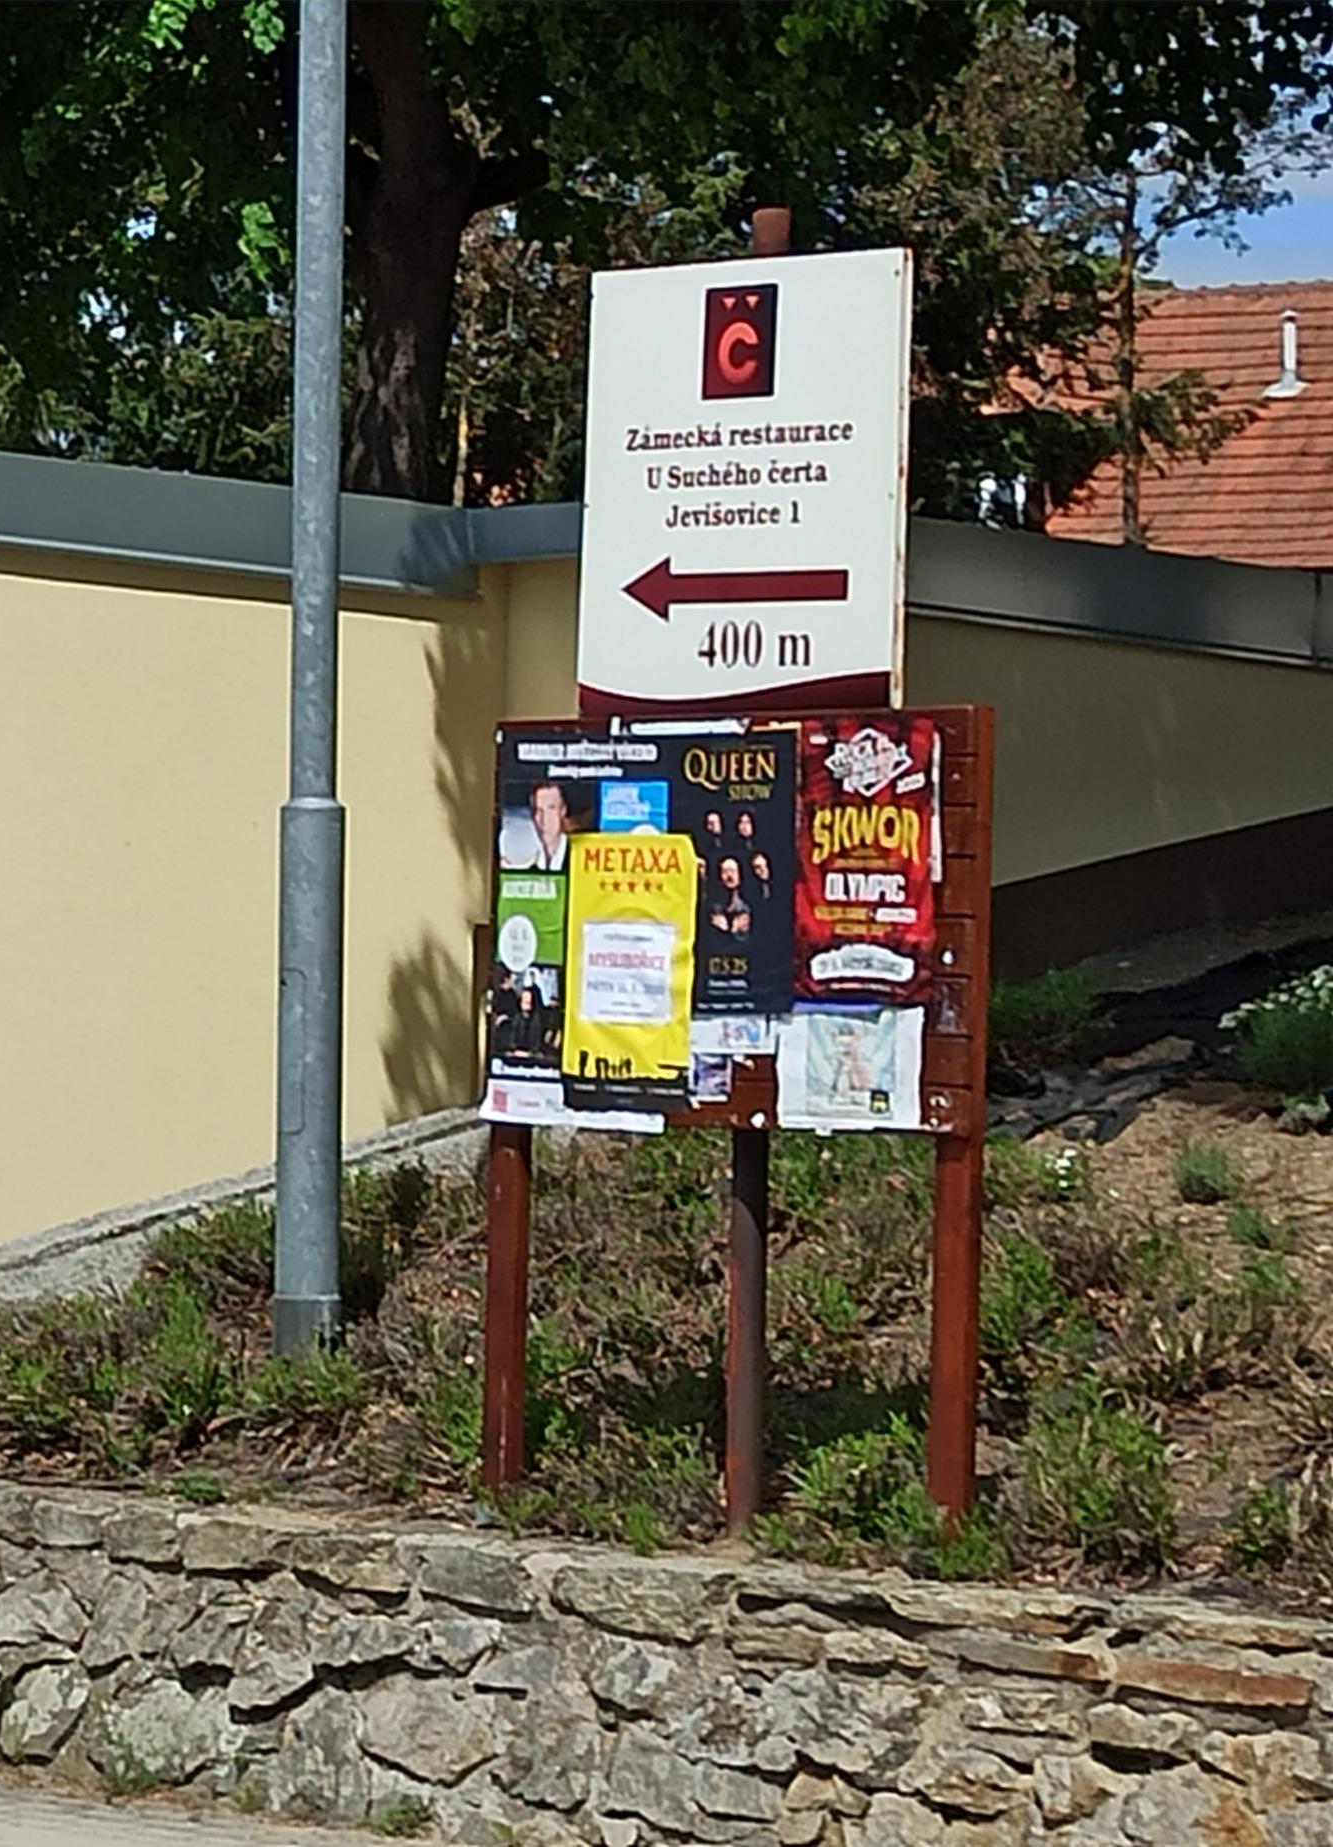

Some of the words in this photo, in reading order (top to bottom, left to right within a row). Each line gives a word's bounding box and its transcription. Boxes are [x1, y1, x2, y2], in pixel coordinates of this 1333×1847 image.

[625, 423, 723, 451] Zámecká
[729, 423, 854, 446] restaurace
[647, 467, 661, 490] U
[667, 461, 761, 489] Suchého
[768, 460, 828, 484] čerta
[666, 502, 781, 529] Jevišovice
[790, 500, 801, 524] 1
[697, 619, 763, 669] 400
[777, 633, 811, 667] m
[683, 747, 777, 791] QUEEN
[582, 847, 683, 874] METAXA
[824, 872, 906, 903] OLYMPIC
